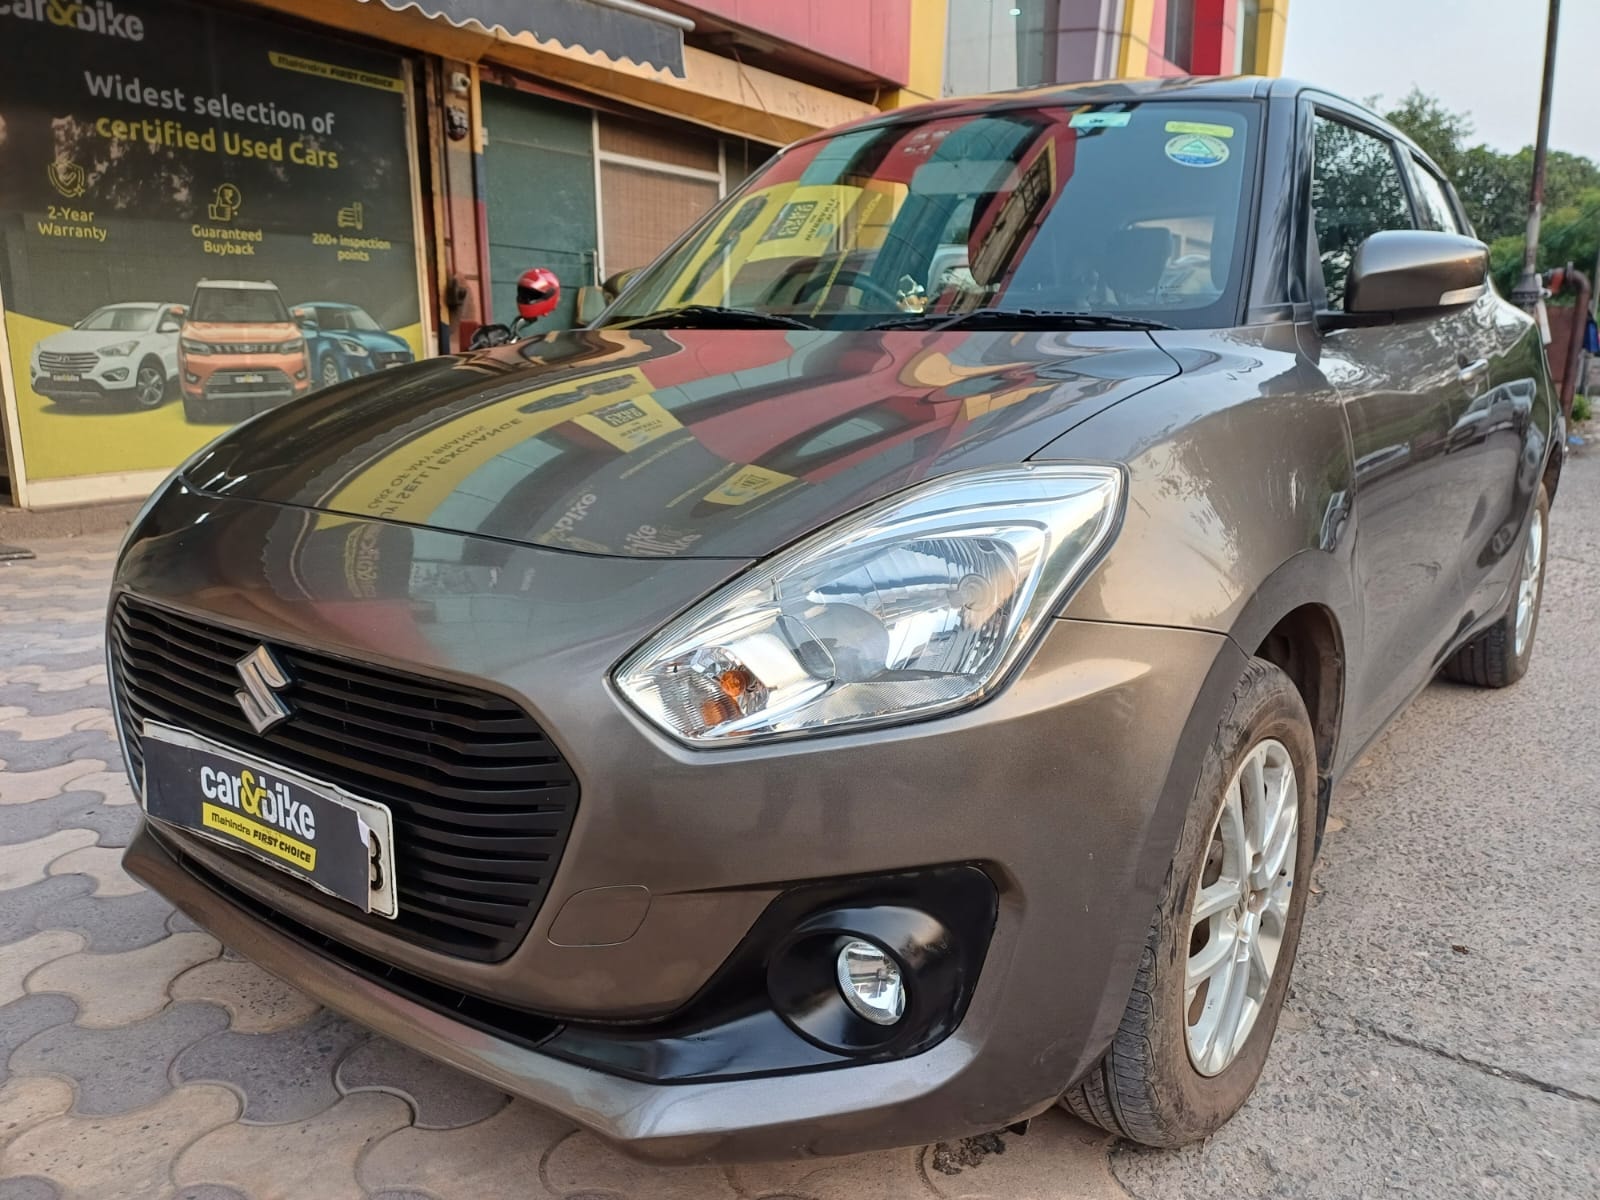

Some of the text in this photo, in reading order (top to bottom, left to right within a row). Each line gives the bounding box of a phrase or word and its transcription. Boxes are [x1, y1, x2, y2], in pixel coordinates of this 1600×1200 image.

[84, 70, 335, 135] Widest selection of
[95, 115, 339, 169] certified Used Cars
[47, 205, 95, 222] 2-Year
[38, 221, 107, 242] Warranty
[191, 224, 263, 242] Guaranteed
[203, 241, 255, 256] Buyback
[312, 233, 392, 251] 200+ inspection
[337, 248, 370, 262] points
[200, 766, 316, 840] car&bike
[211, 812, 312, 863] Mahindra FIRST CHOICE
